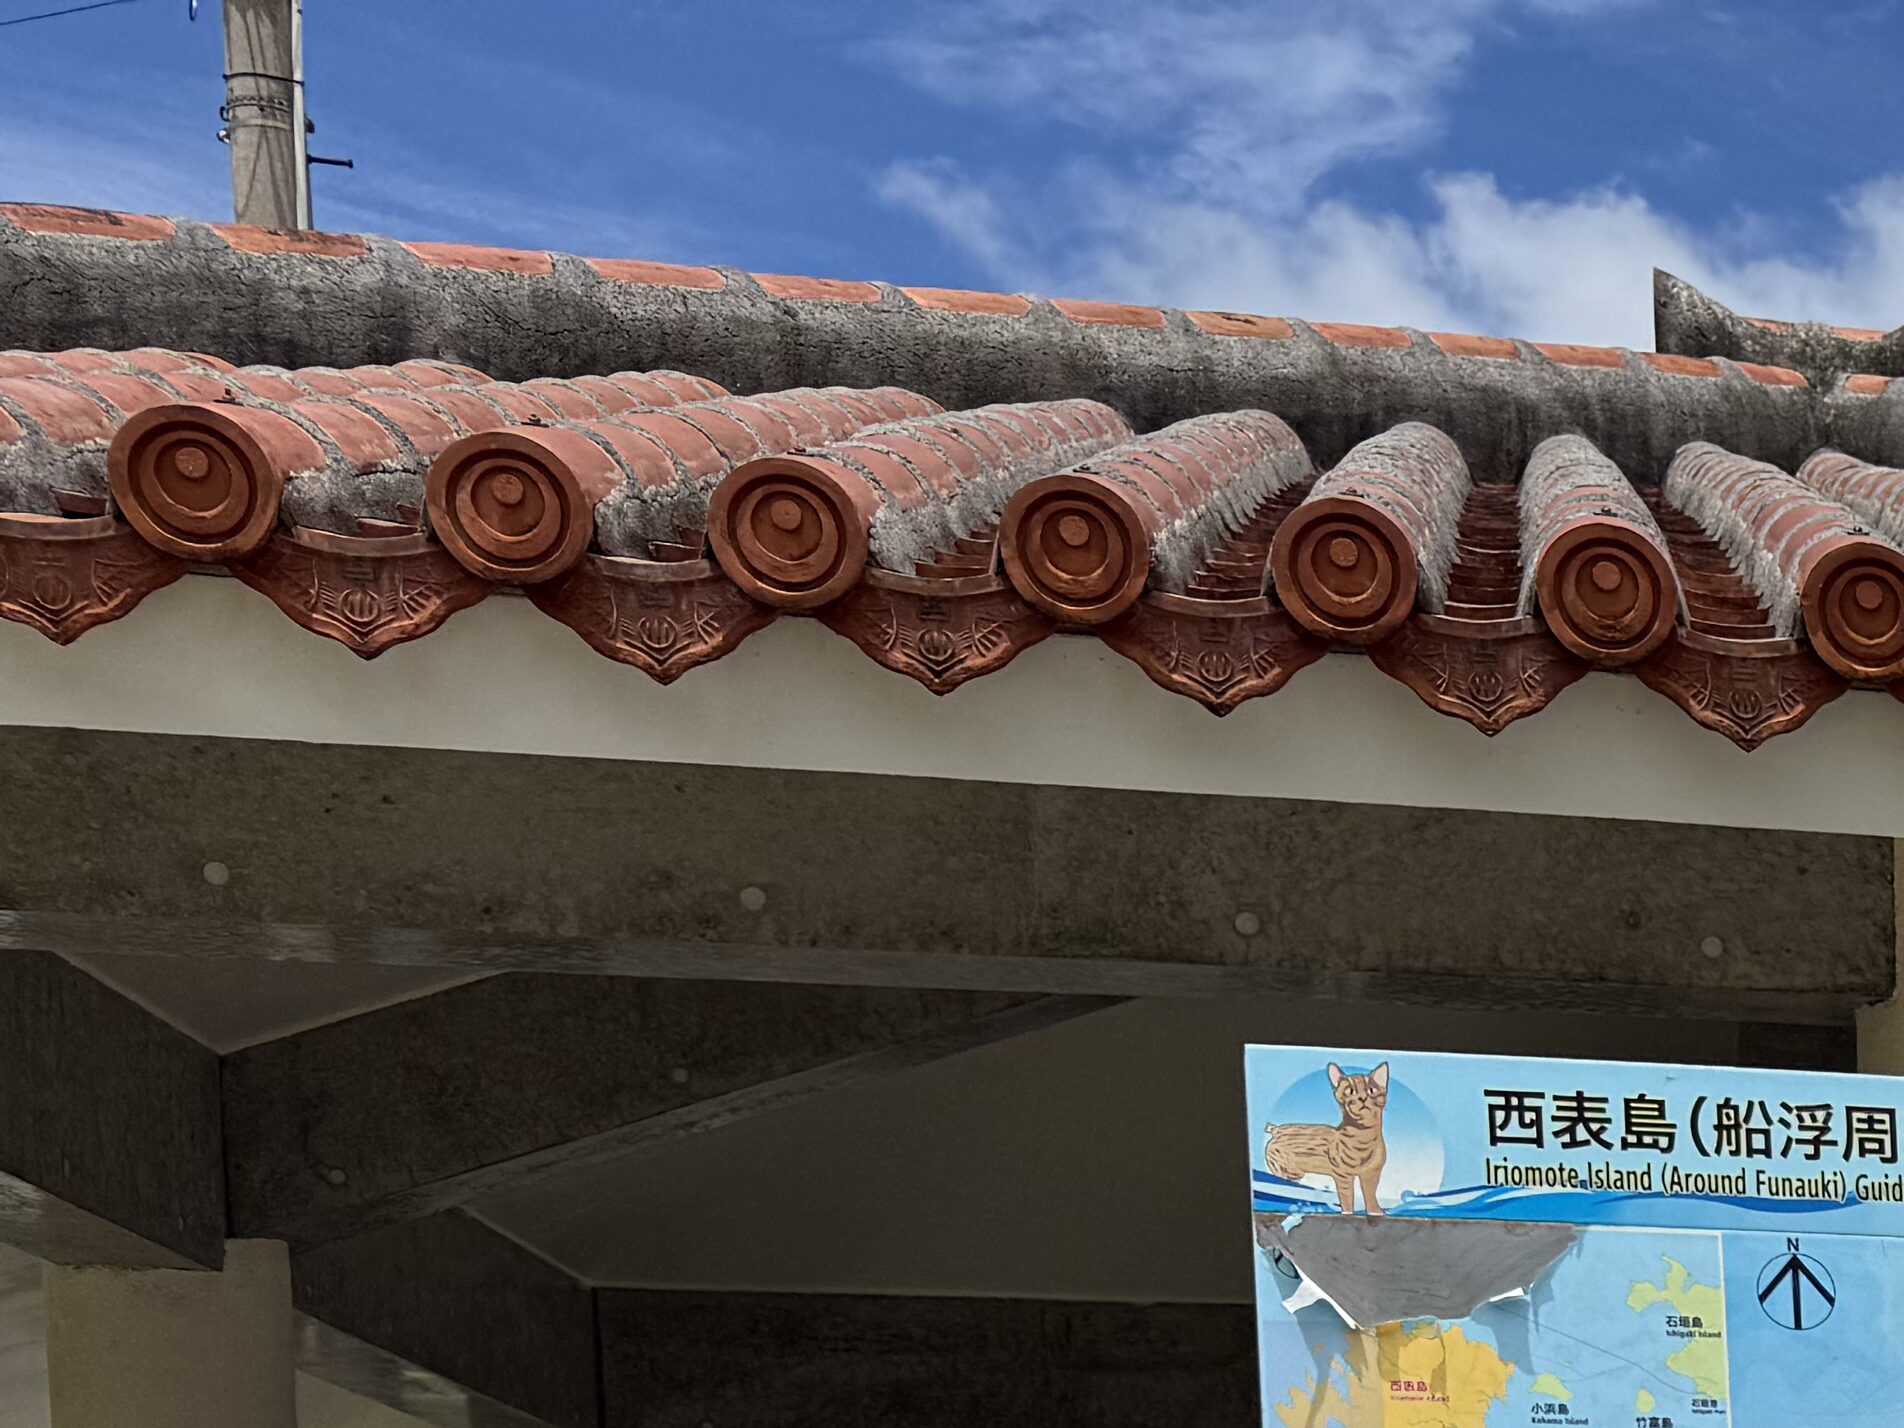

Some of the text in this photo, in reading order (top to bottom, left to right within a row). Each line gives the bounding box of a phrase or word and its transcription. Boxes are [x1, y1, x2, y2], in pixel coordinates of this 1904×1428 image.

[1486, 1158, 1579, 1189] Iriomote
[1588, 1162, 1652, 1193] Island
[1662, 1165, 1747, 1197] (Around
[1756, 1169, 1846, 1202] Funauki)
[1787, 1237, 1799, 1252] N
[1666, 1316, 1703, 1329] 石垣島
[1531, 1403, 1569, 1415] 小浜島
[1636, 1417, 1673, 1428] 竹富島
